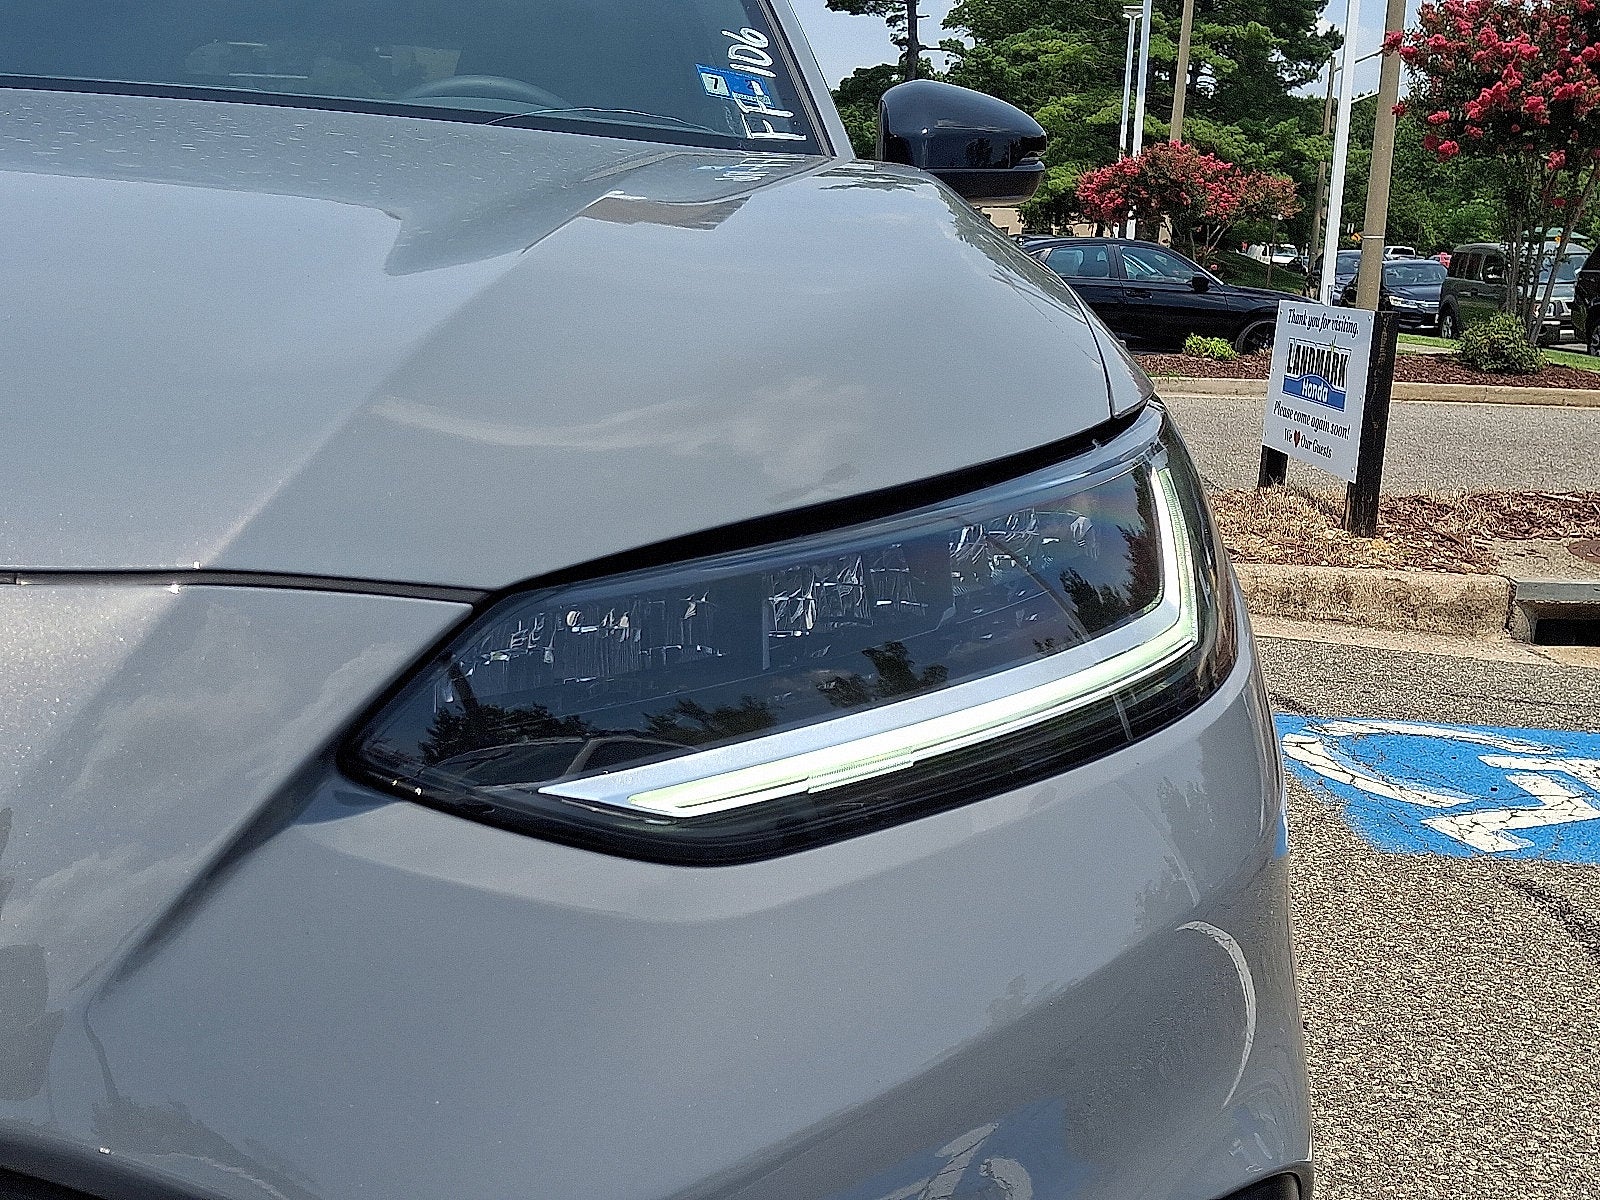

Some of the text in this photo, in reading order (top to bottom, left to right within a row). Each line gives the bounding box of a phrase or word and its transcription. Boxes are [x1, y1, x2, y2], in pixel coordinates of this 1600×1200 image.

[1287, 308, 1308, 327] Thank
[1307, 315, 1320, 331] you
[1319, 312, 1331, 333] for
[1286, 341, 1350, 390] LANDMARK
[1301, 377, 1328, 403] Honda
[1273, 400, 1351, 441] Please come again soon!
[1284, 427, 1332, 459] We Our Guests
